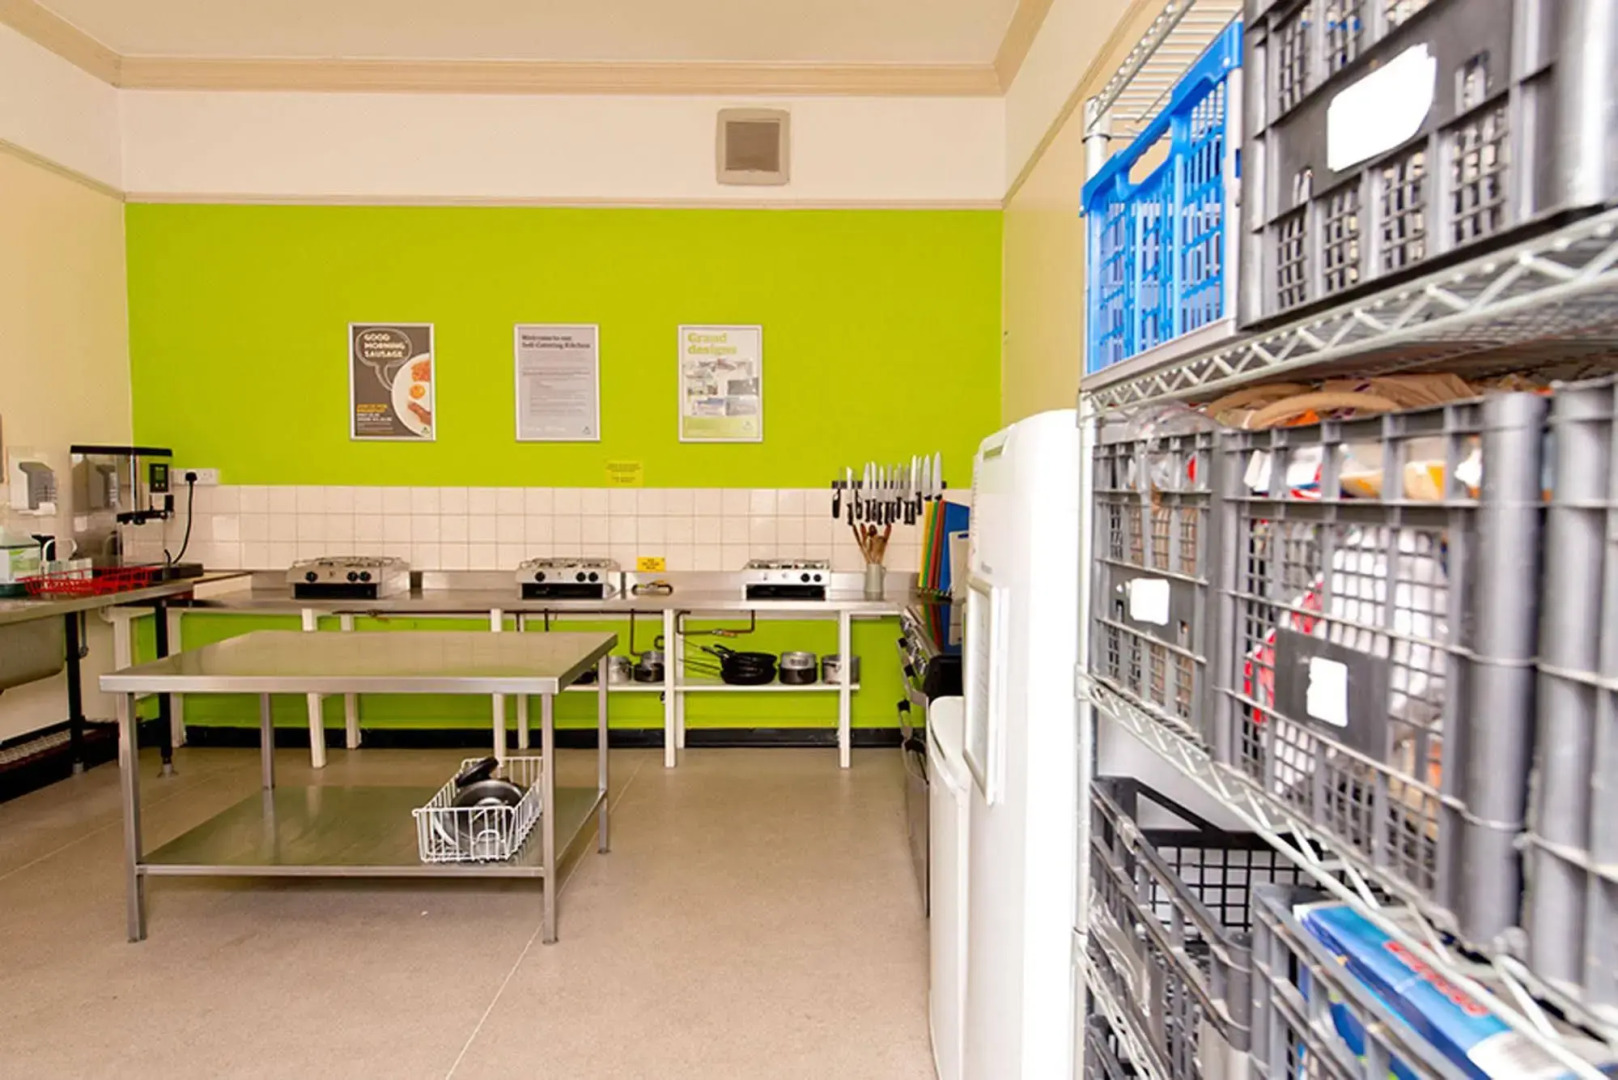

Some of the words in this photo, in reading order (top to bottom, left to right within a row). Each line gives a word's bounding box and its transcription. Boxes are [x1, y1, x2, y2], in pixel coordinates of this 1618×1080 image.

[364, 333, 390, 341] GOOD
[687, 332, 727, 343] Grand
[364, 342, 405, 350] MORNING
[364, 350, 403, 358] SAUSAGE
[687, 345, 737, 356] designs
